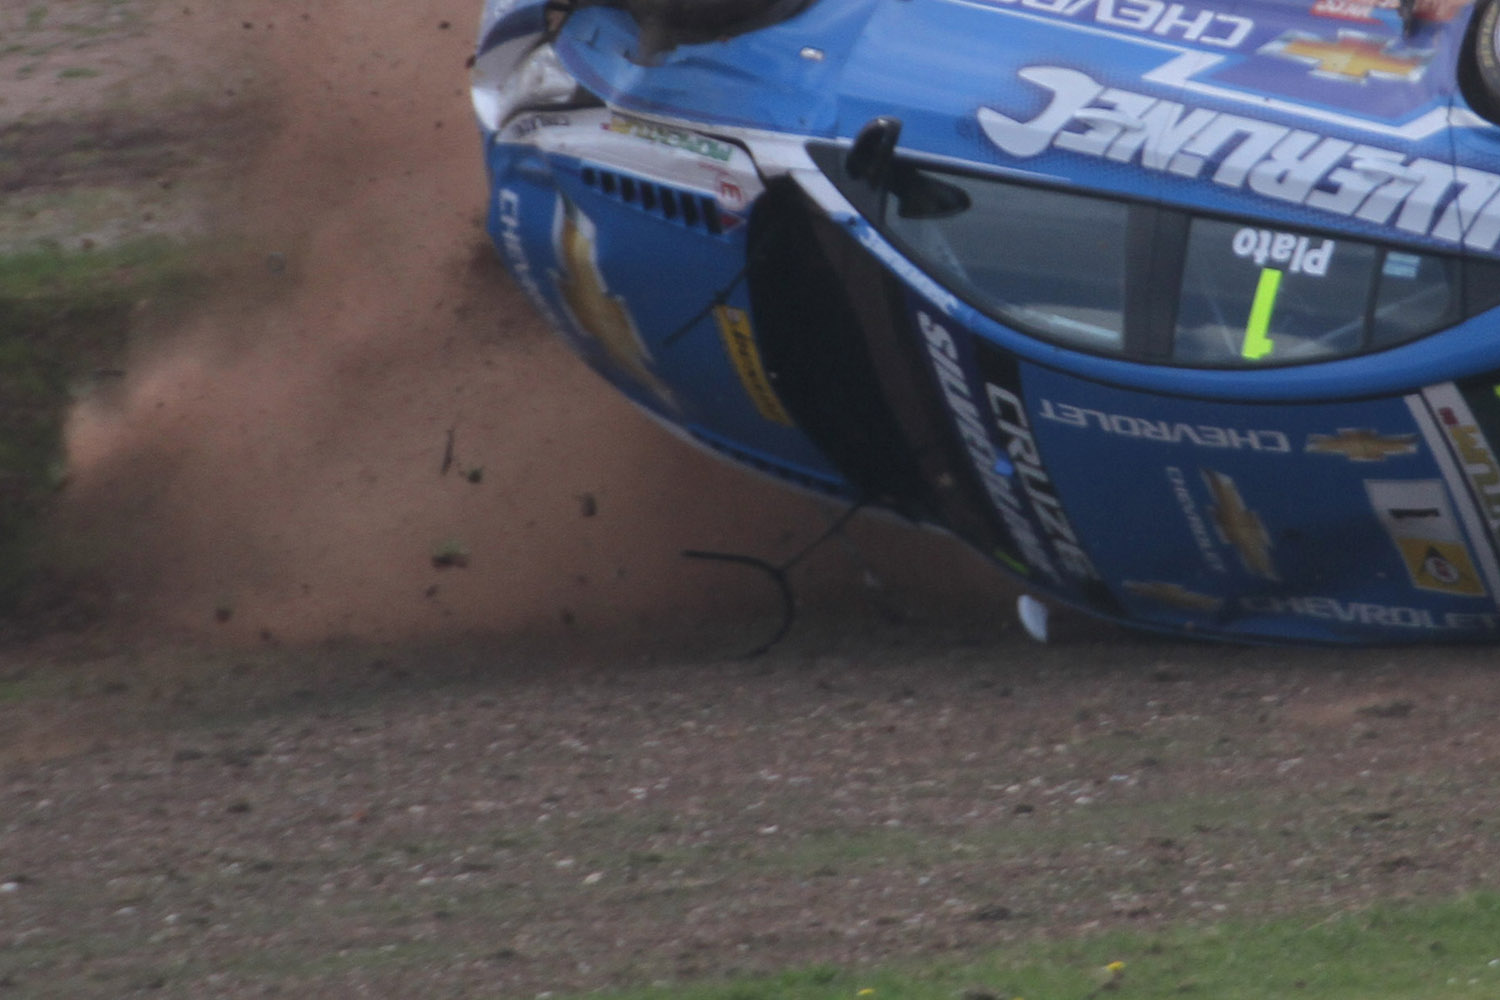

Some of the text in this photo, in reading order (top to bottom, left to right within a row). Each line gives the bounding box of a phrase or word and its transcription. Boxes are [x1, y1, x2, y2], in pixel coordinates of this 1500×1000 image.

[1233, 227, 1335, 276] Plato
[1241, 267, 1283, 360] 1
[1041, 398, 1291, 453] CHEVROLET
[985, 381, 1098, 580] CRUZE
[1389, 507, 1440, 520] 1
